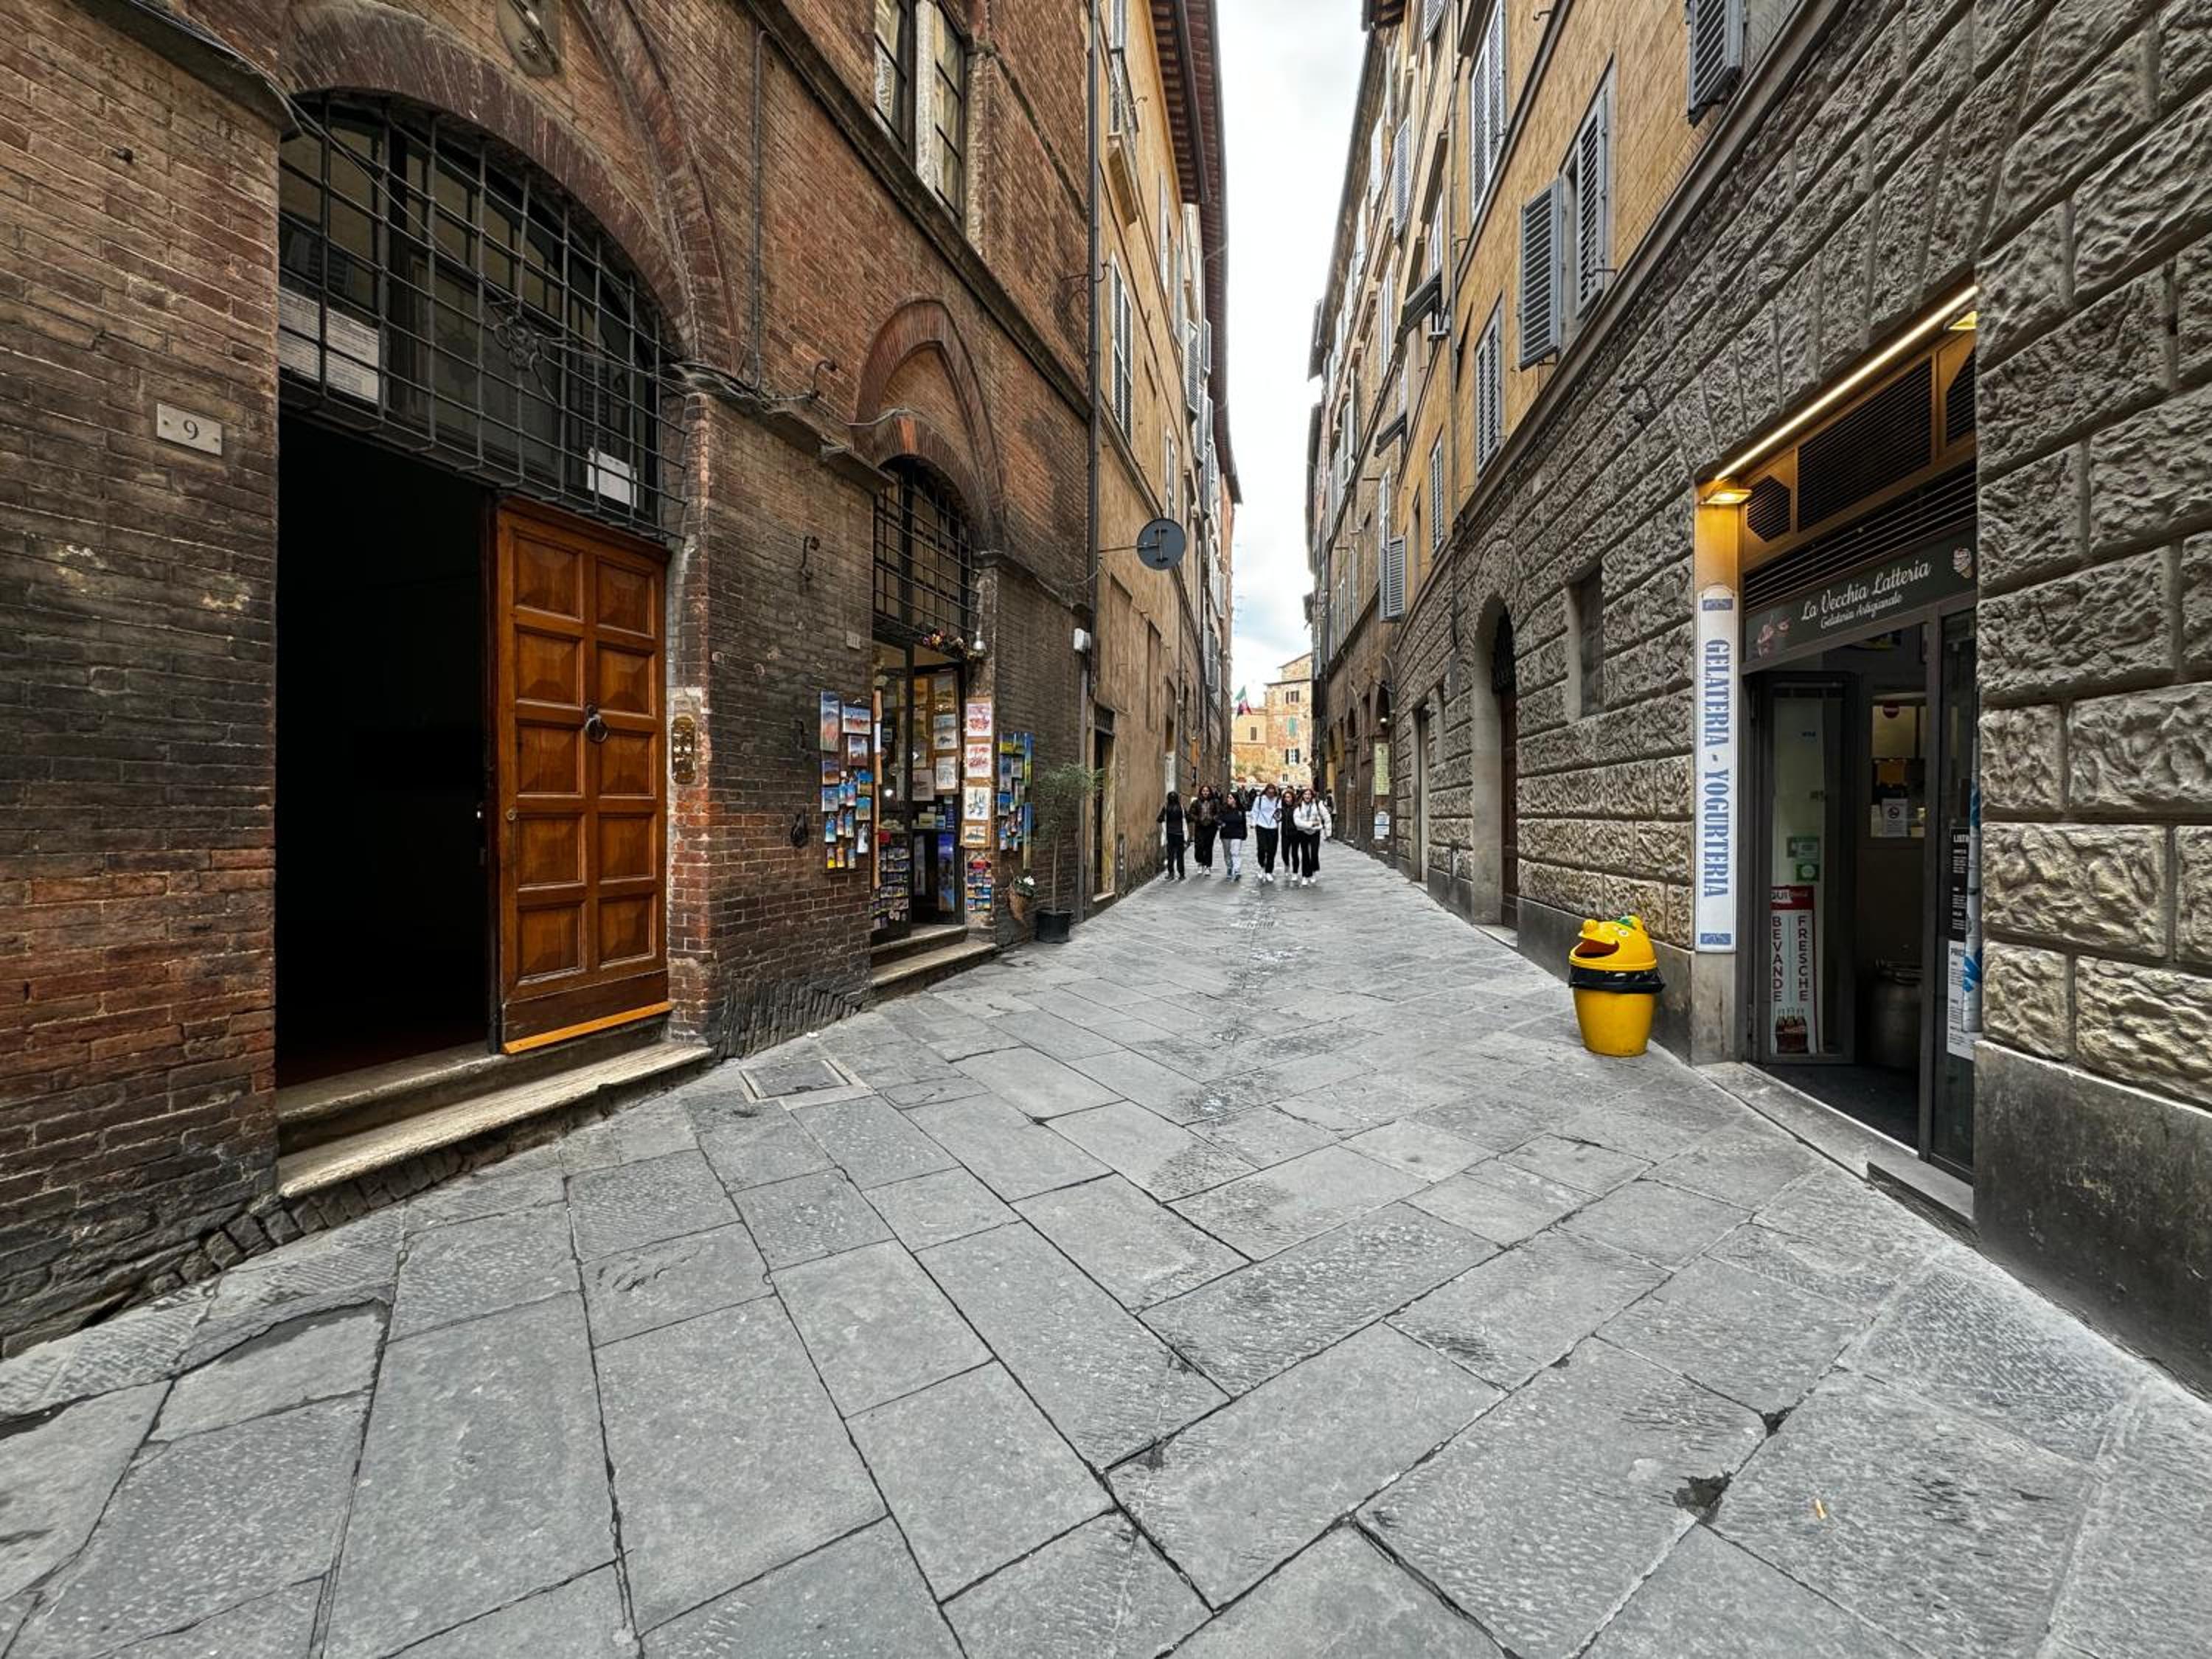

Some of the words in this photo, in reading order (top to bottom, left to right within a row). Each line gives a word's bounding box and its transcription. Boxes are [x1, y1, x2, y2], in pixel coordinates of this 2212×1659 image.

[183, 420, 199, 440] 9
[1801, 600, 1818, 621] La
[1821, 582, 1868, 613] Vecchia
[1871, 560, 1932, 594] Latteria
[1705, 639, 1731, 747] GELATERIA
[1704, 769, 1729, 897] YOGURTERIA
[1772, 916, 1783, 1002] BEVANDE
[1798, 915, 1808, 1001] FRESCHE
